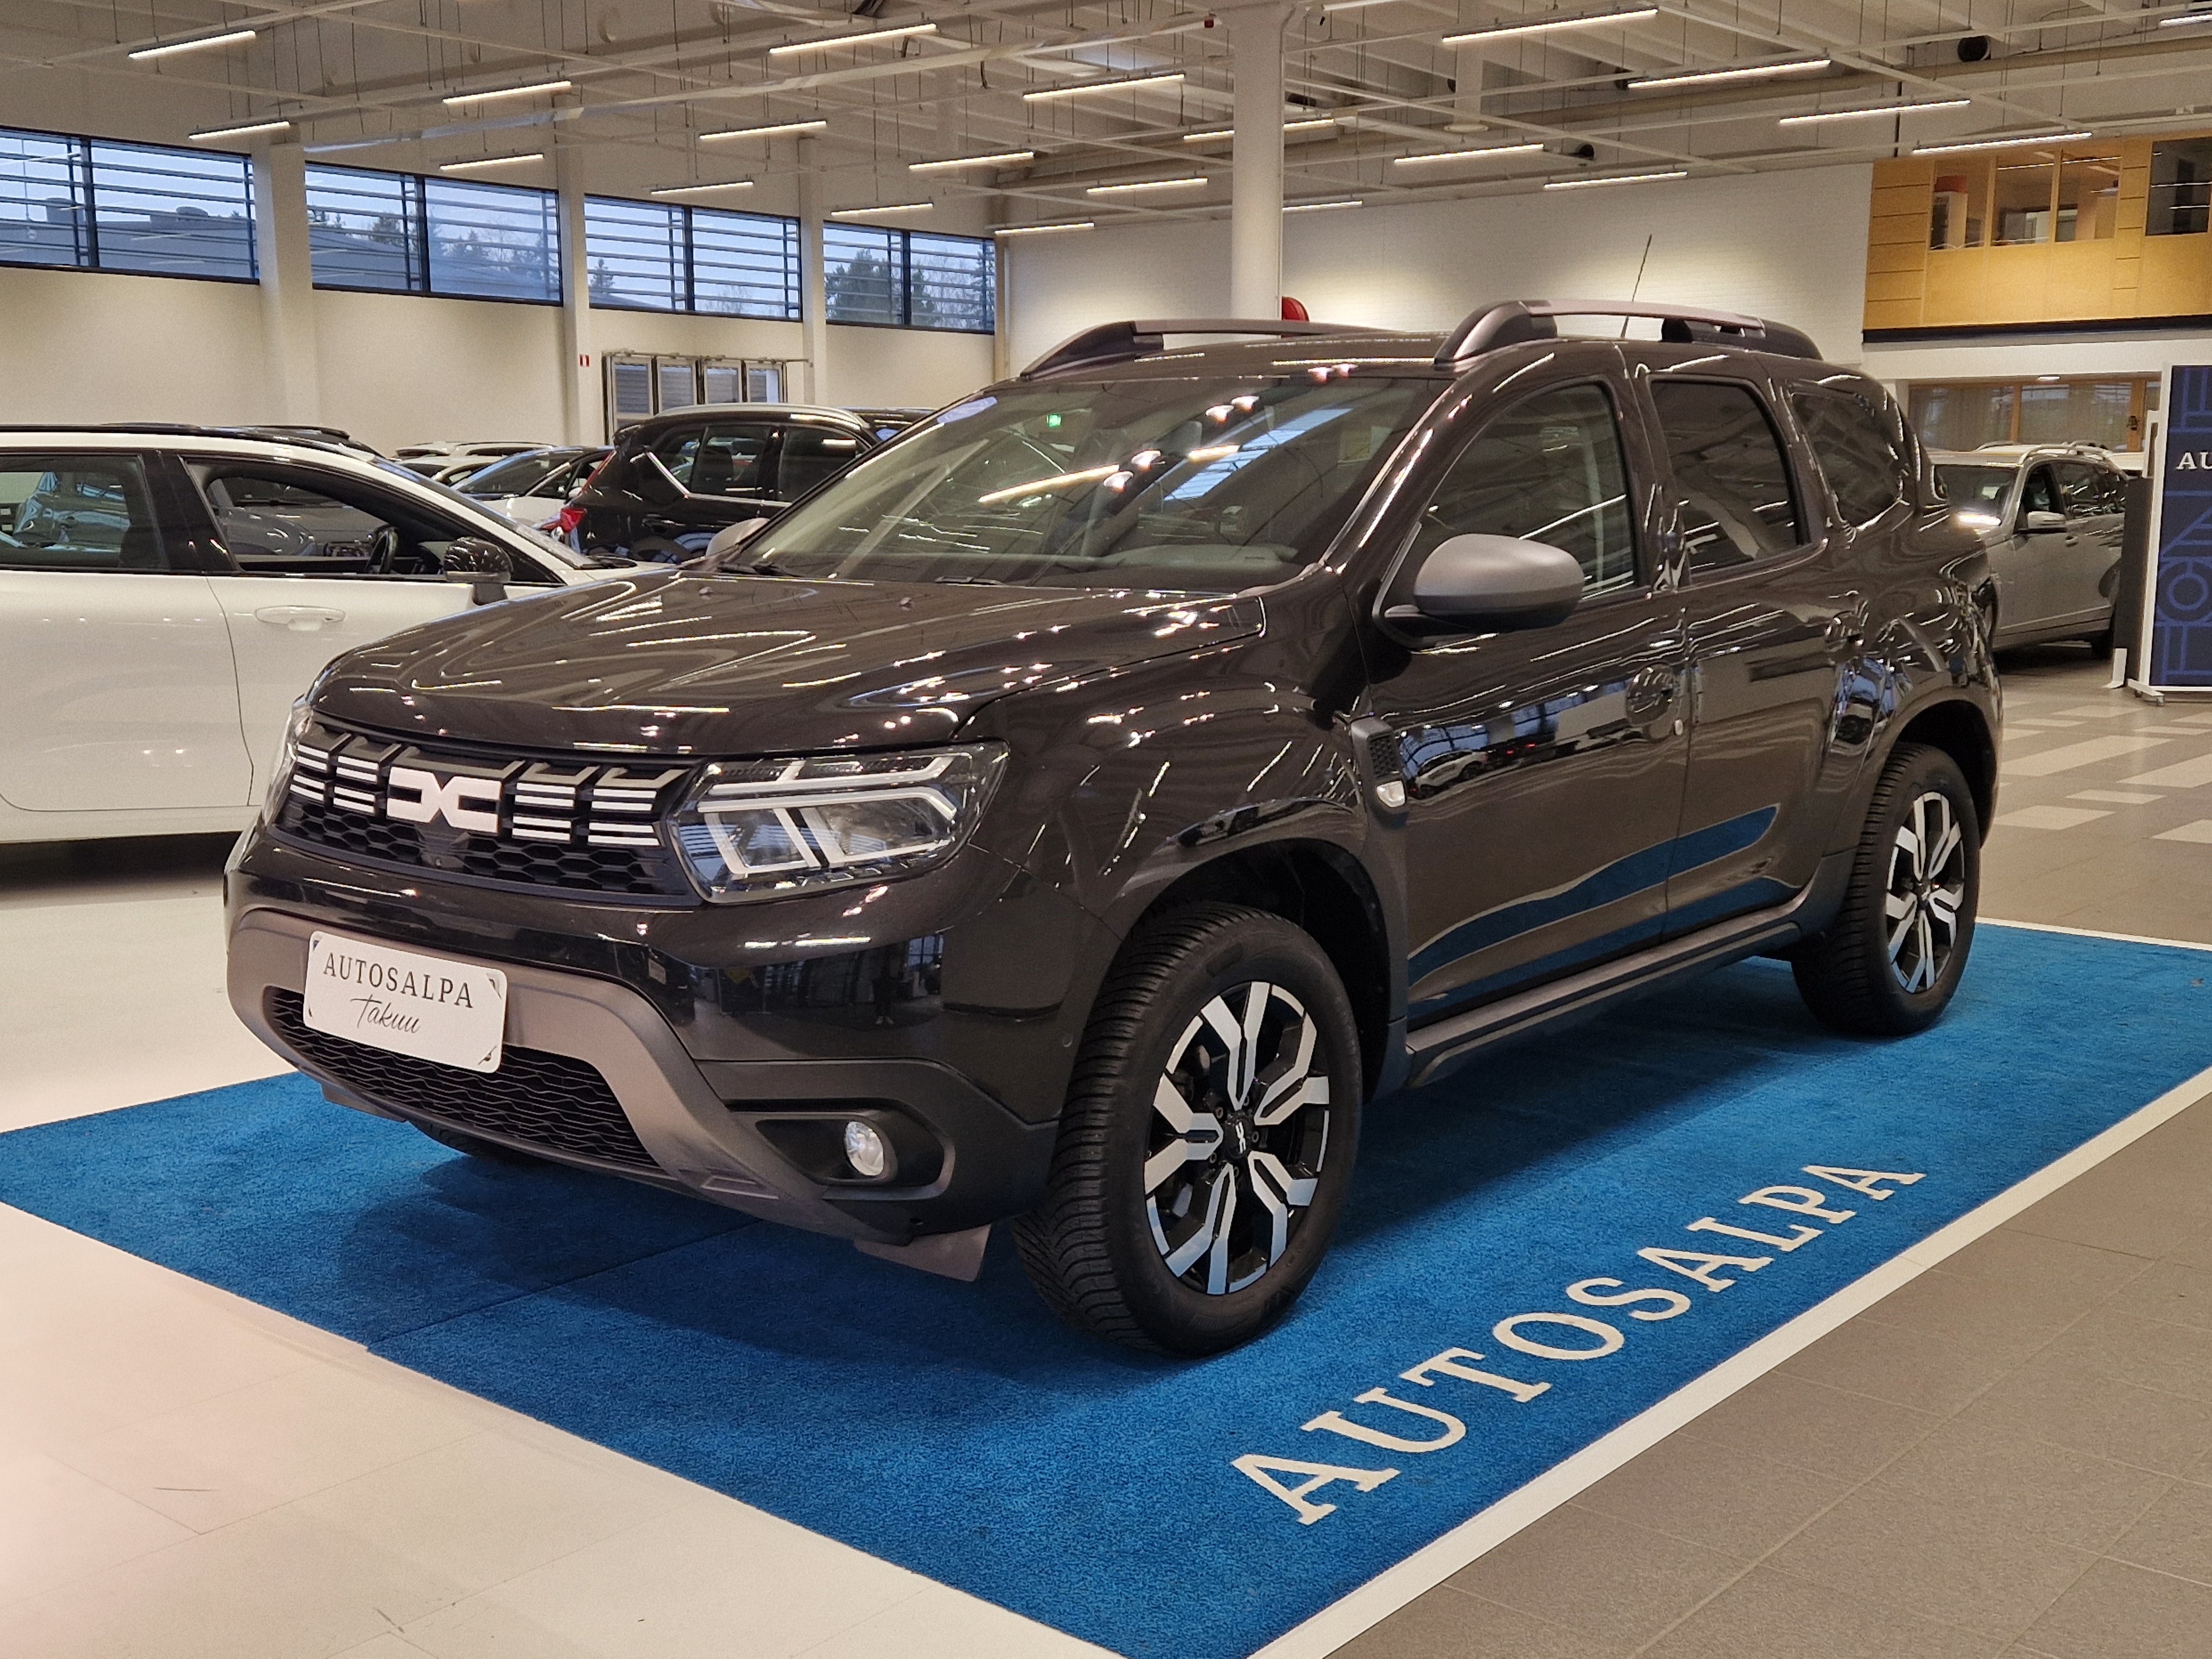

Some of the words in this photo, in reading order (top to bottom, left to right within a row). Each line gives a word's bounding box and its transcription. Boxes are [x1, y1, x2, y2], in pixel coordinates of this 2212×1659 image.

[2176, 451, 2212, 470] AU
[323, 953, 473, 1008] AUTOSALPA
[351, 994, 420, 1034] Takuu
[1231, 1164, 1927, 1525] AUTOSALPA
